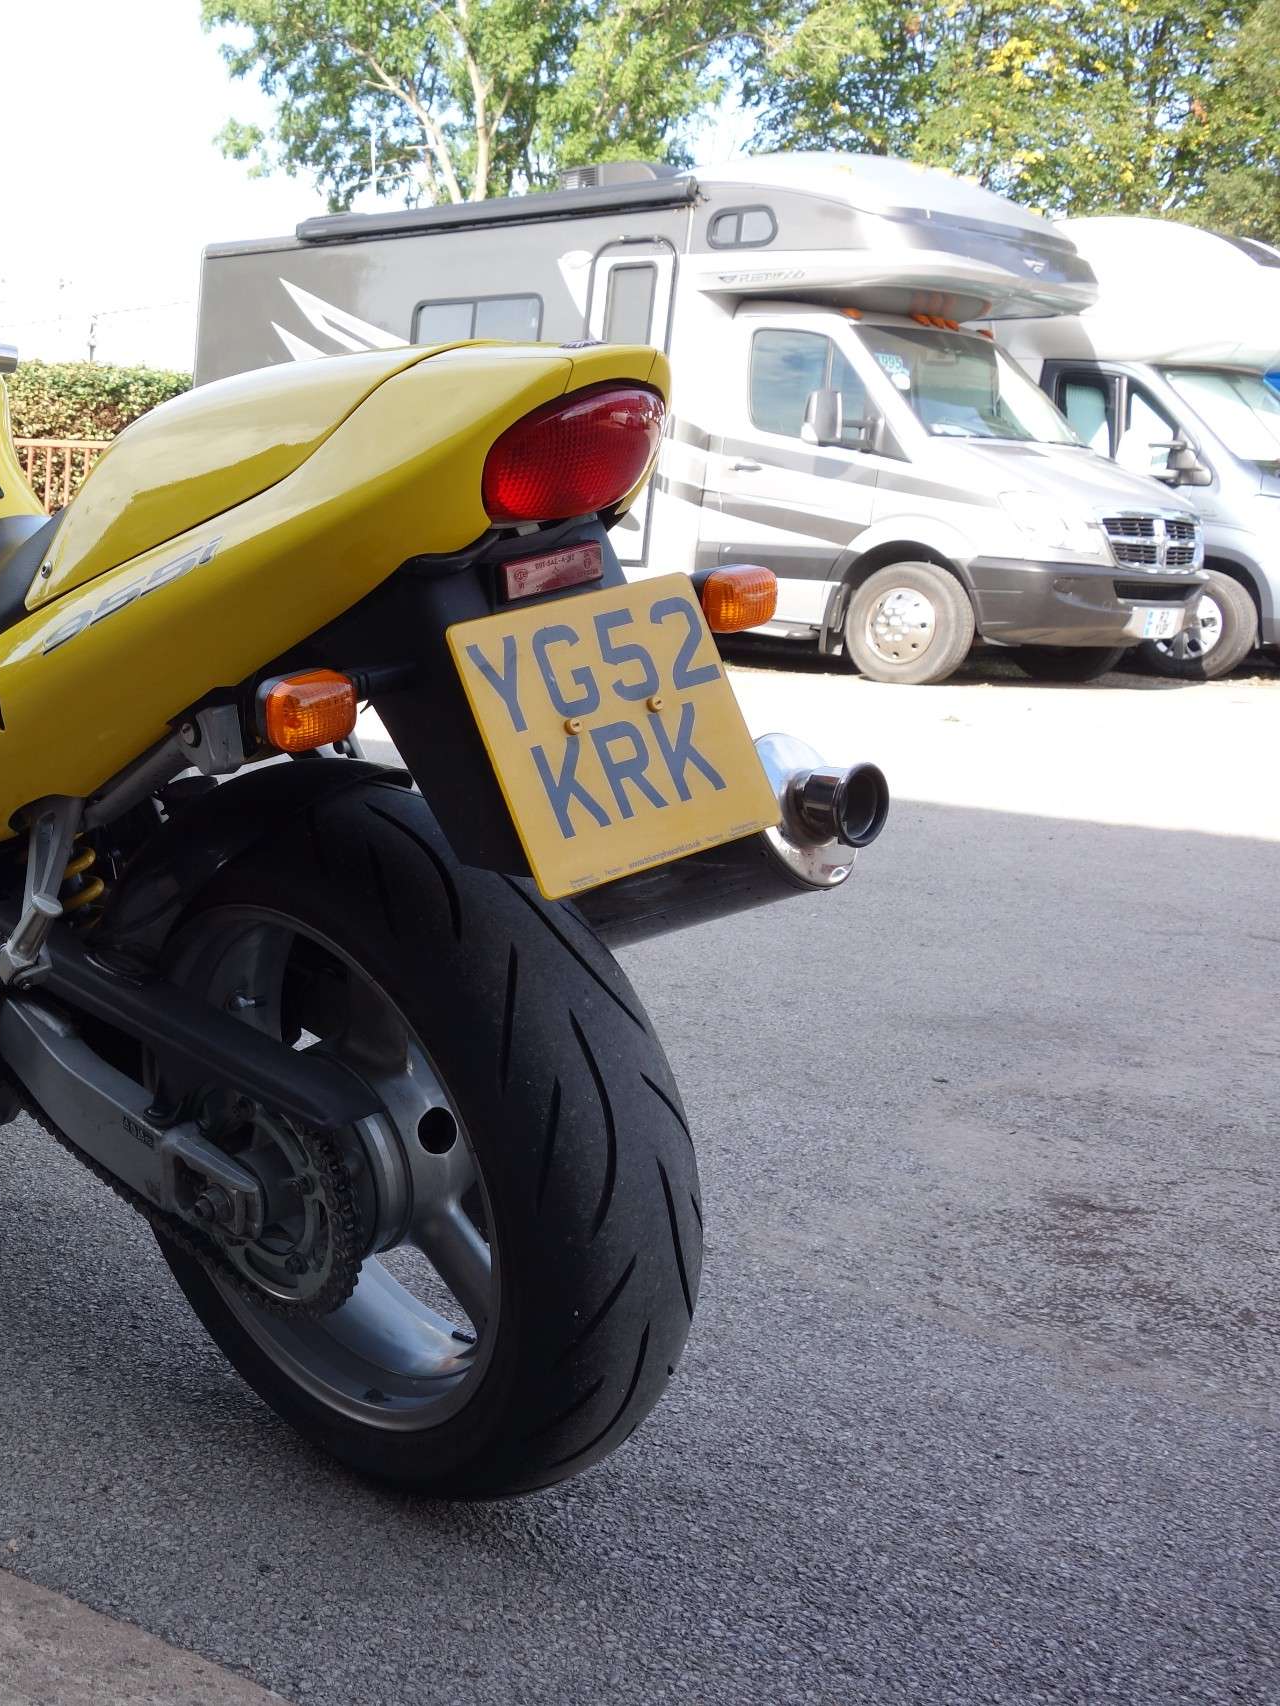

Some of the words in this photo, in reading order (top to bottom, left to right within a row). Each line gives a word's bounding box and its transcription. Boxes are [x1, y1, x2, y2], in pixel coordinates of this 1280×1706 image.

[43, 536, 224, 655] 955i
[465, 597, 721, 732] YG52
[531, 703, 727, 840] KRK
